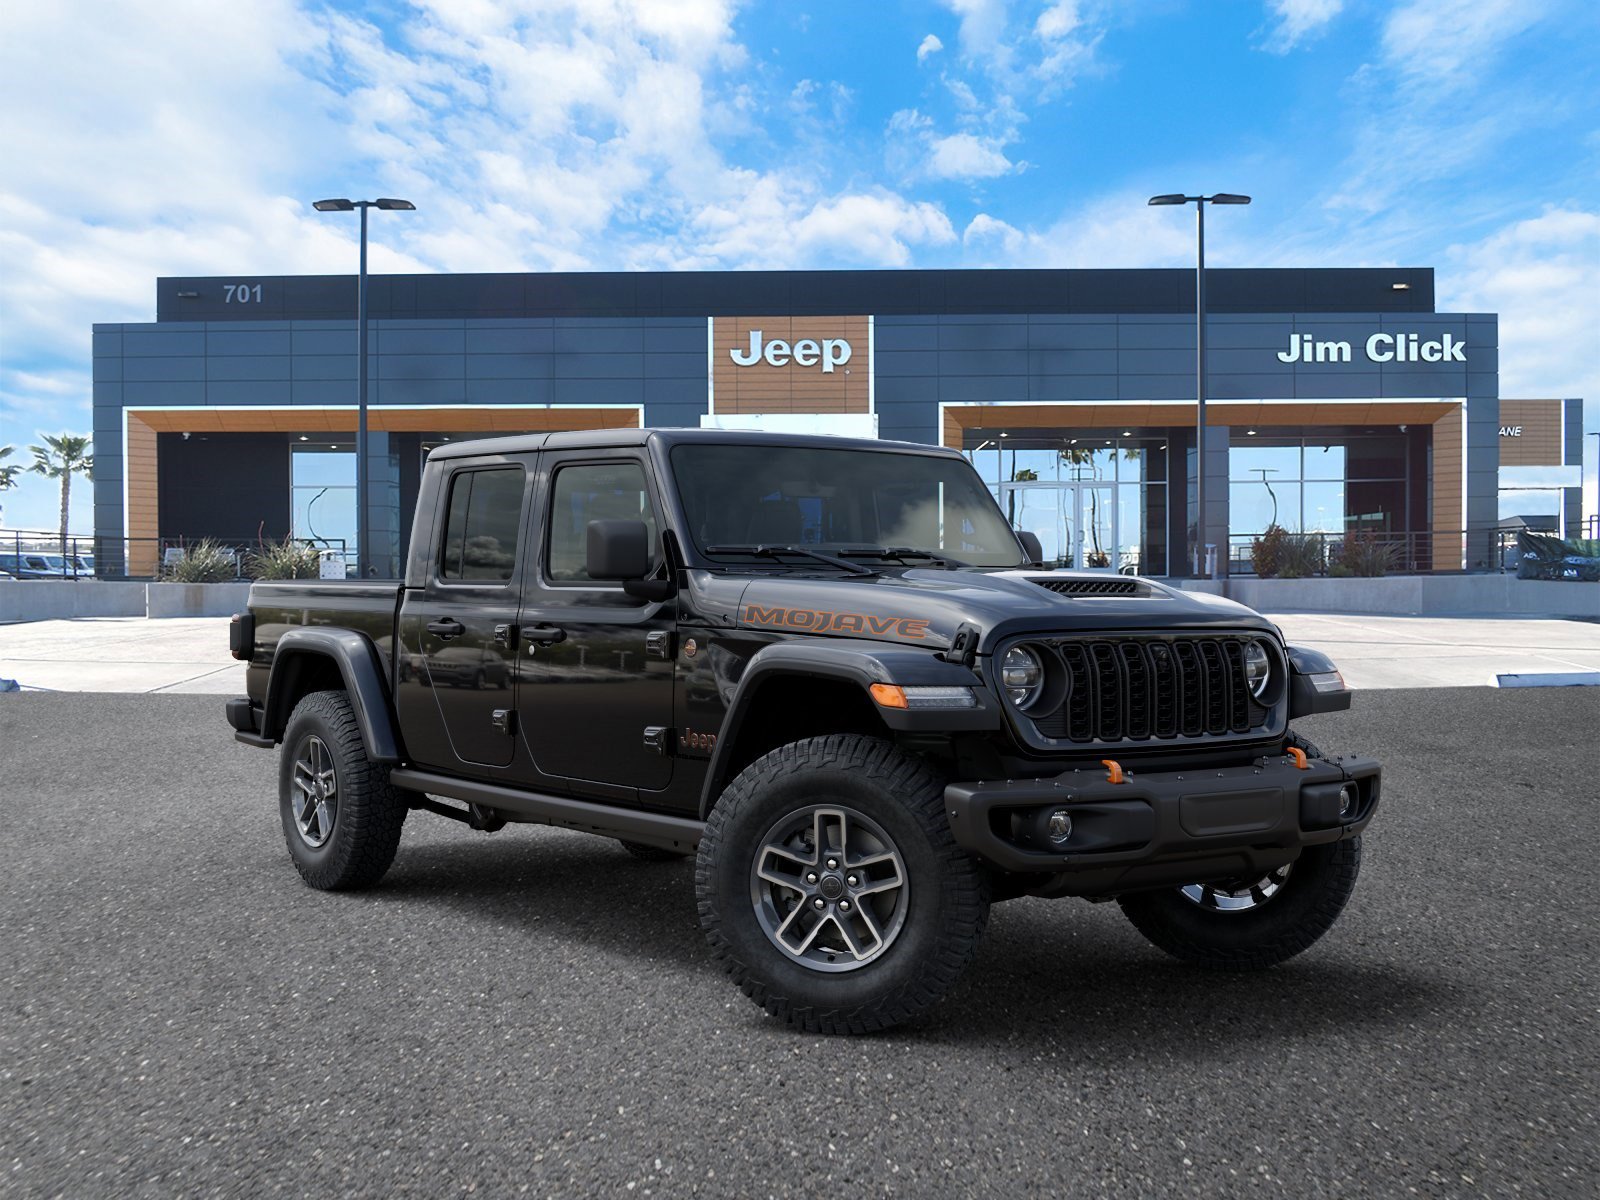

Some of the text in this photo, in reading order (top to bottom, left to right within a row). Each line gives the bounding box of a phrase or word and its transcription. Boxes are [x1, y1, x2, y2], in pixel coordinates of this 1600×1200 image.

[223, 284, 262, 303] 701
[729, 330, 852, 373] Jeep
[1277, 333, 1467, 363] Jim Click
[744, 604, 930, 640] MOJAVE
[680, 727, 717, 754] Jeep
